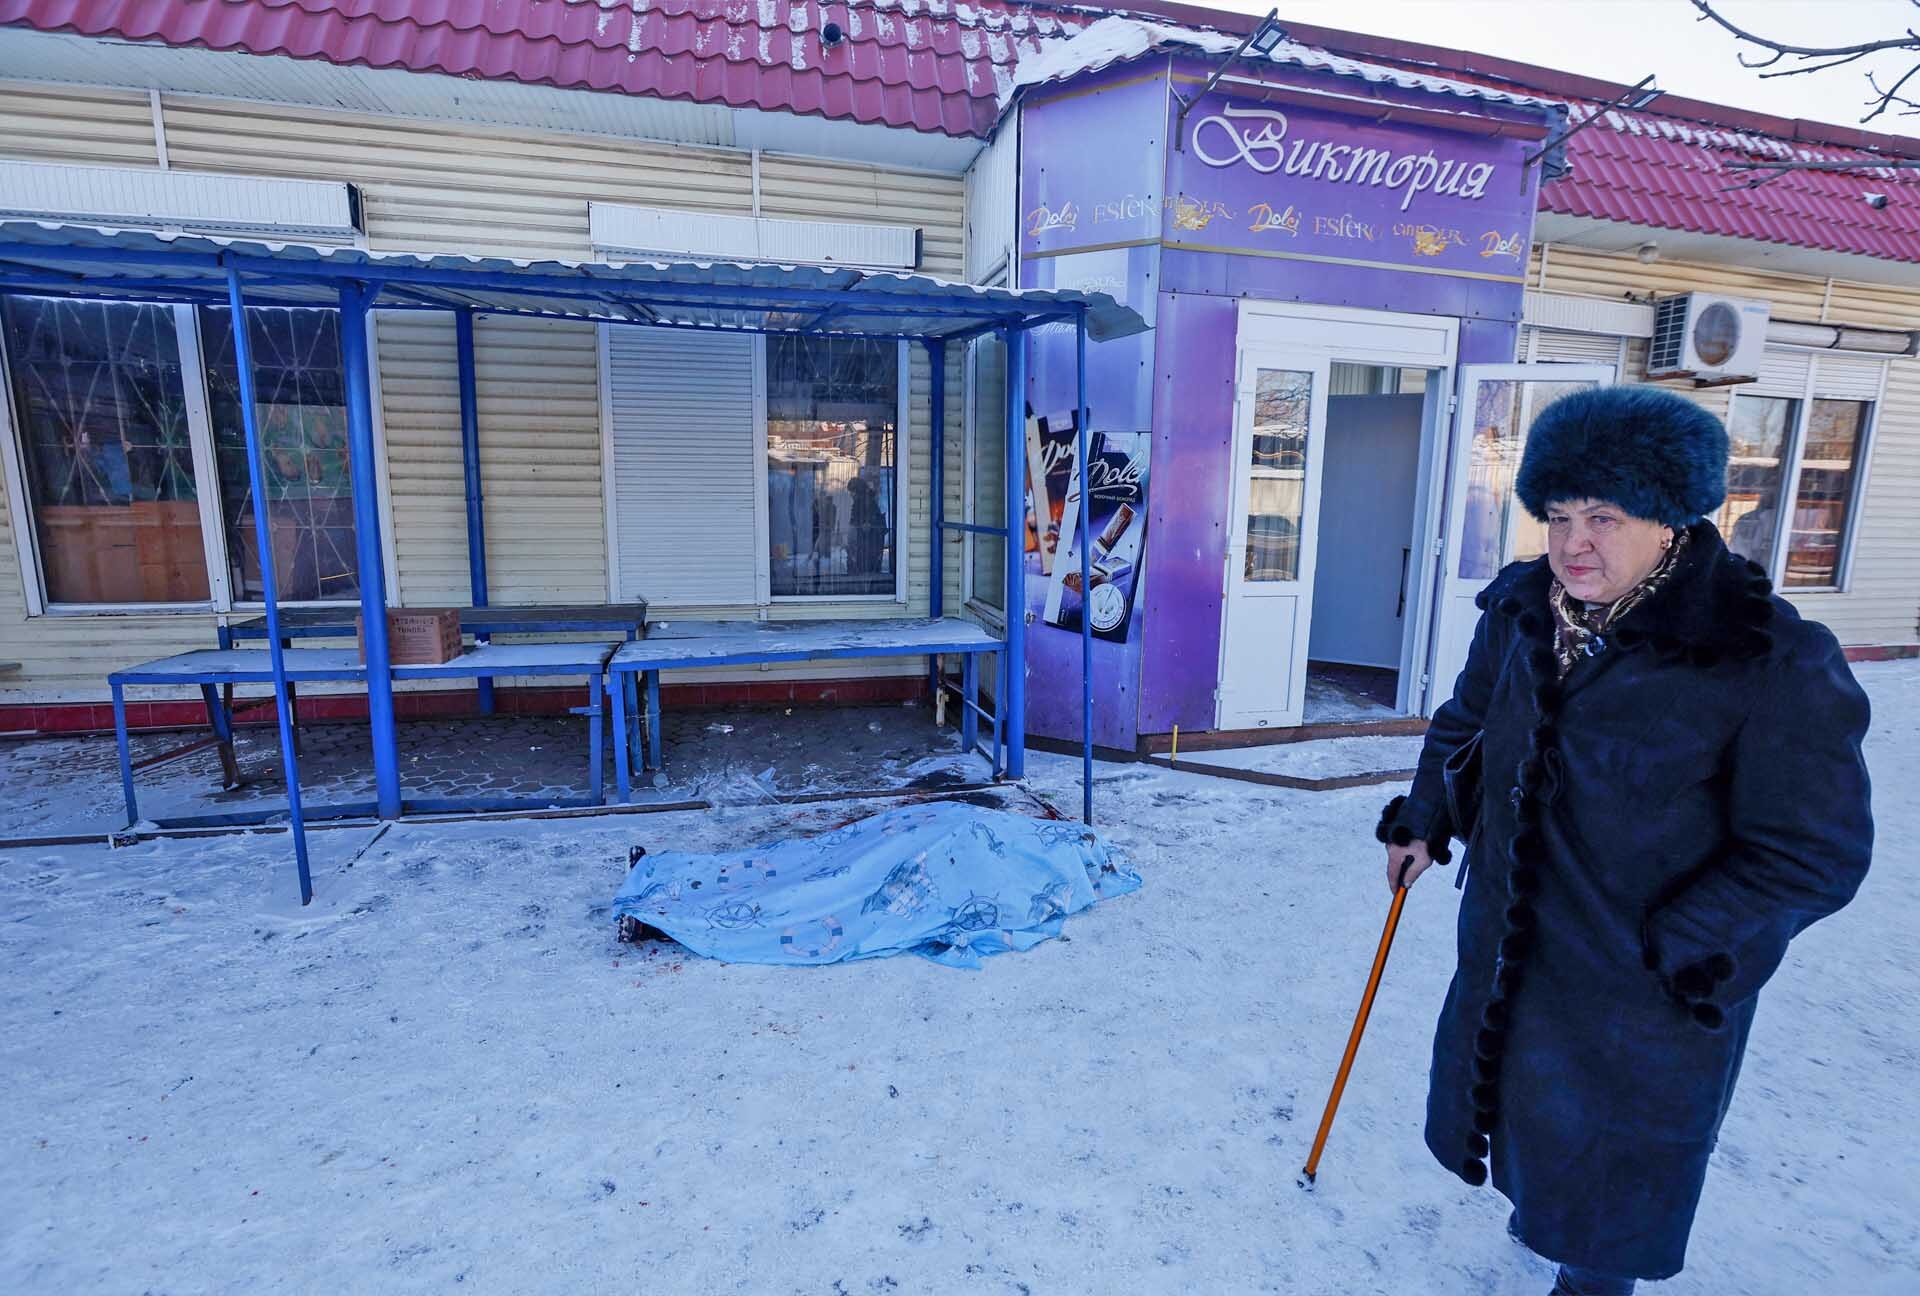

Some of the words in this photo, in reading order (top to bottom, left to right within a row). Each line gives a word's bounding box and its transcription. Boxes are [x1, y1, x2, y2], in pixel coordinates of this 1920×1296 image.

[1192, 101, 1495, 211] Виктория
[1027, 200, 1079, 237] Dolci
[1248, 202, 1302, 237] Dolci
[1480, 230, 1525, 263] Dolci
